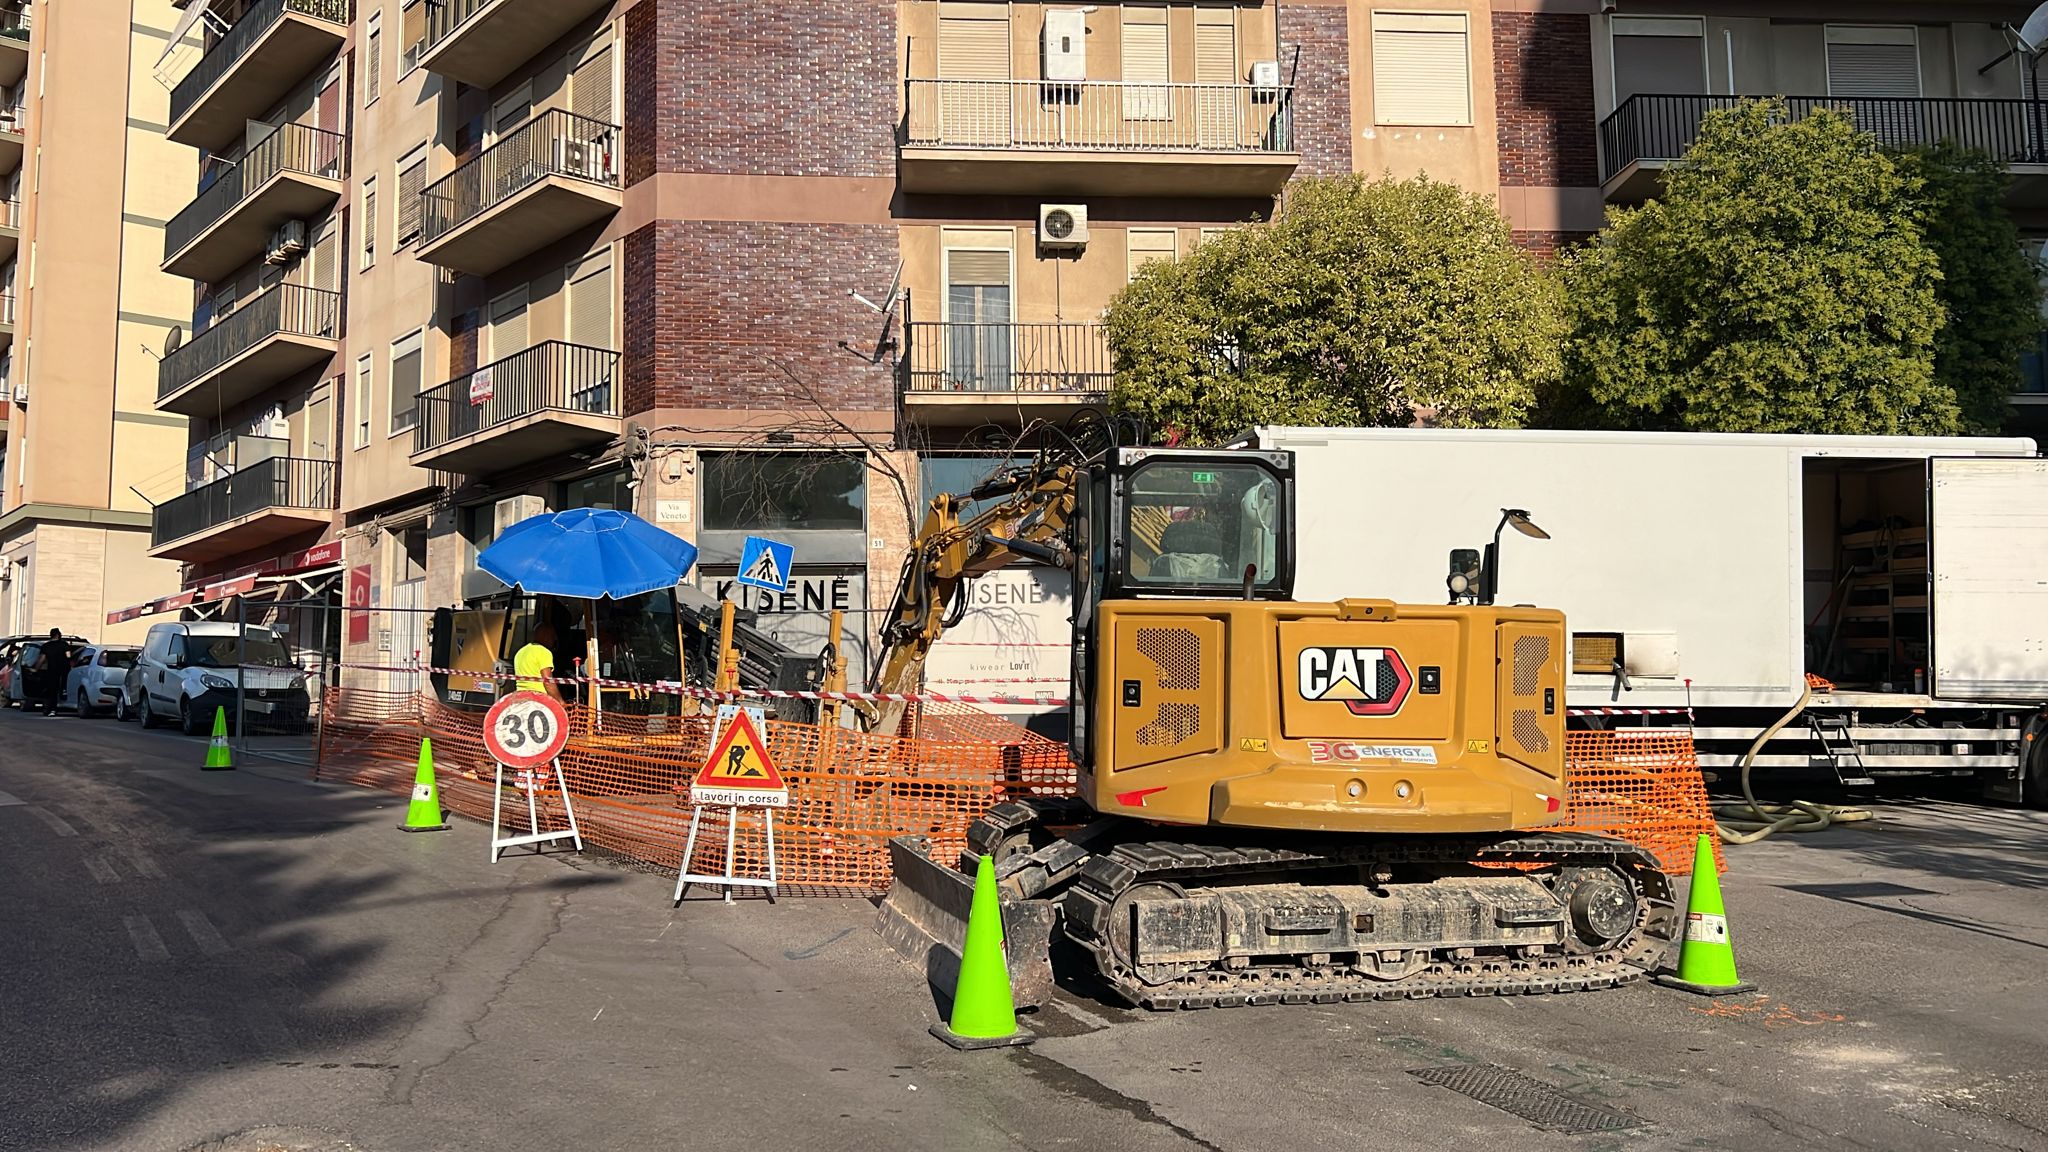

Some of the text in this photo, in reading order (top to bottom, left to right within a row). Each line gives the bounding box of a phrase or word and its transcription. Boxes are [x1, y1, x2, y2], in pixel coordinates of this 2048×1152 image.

[668, 503, 680, 511] Via
[660, 511, 688, 520] Veneto
[1300, 648, 1384, 700] CAT
[502, 709, 550, 749] 30
[1309, 742, 1360, 762] 3G
[1361, 747, 1422, 757] ENERGY
[700, 791, 779, 804] lavori in corso
